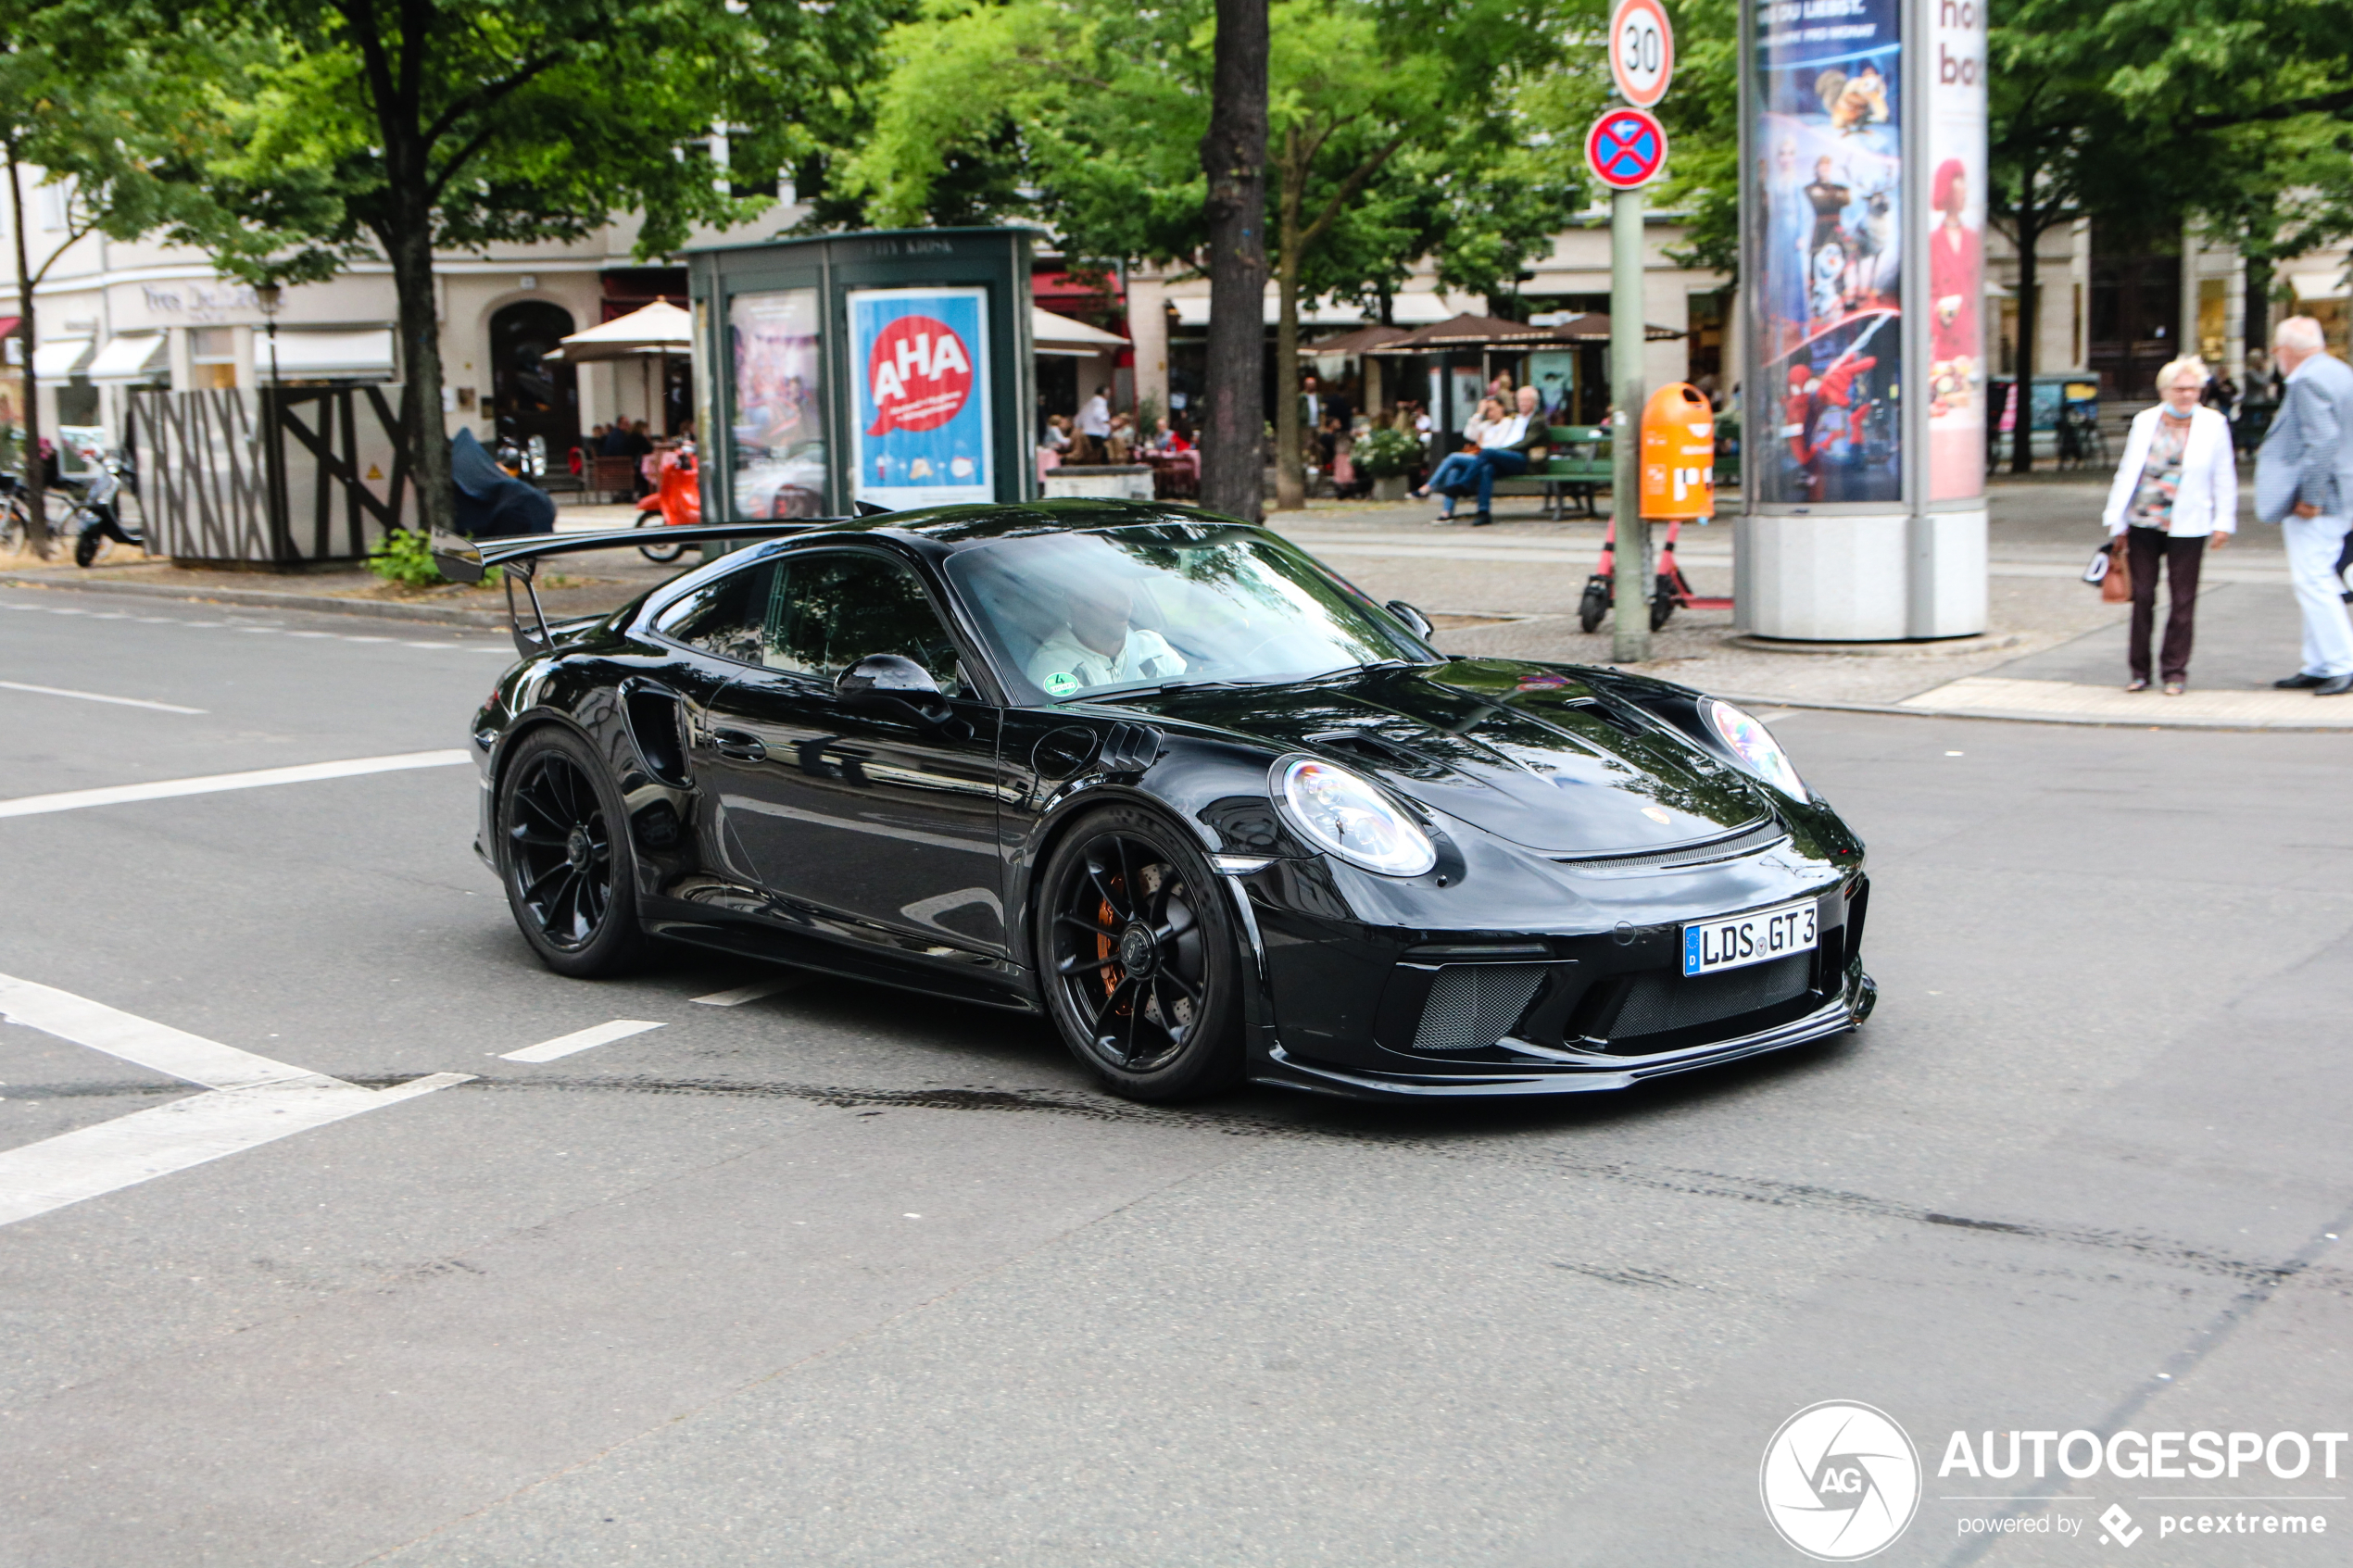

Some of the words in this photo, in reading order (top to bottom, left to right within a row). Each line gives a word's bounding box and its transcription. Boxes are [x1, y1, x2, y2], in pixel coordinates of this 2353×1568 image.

[1626, 26, 1657, 72] 30
[874, 332, 969, 408] AHA
[1055, 673, 1065, 684] 4
[1689, 954, 1696, 966] D
[1703, 922, 1754, 966] LDS
